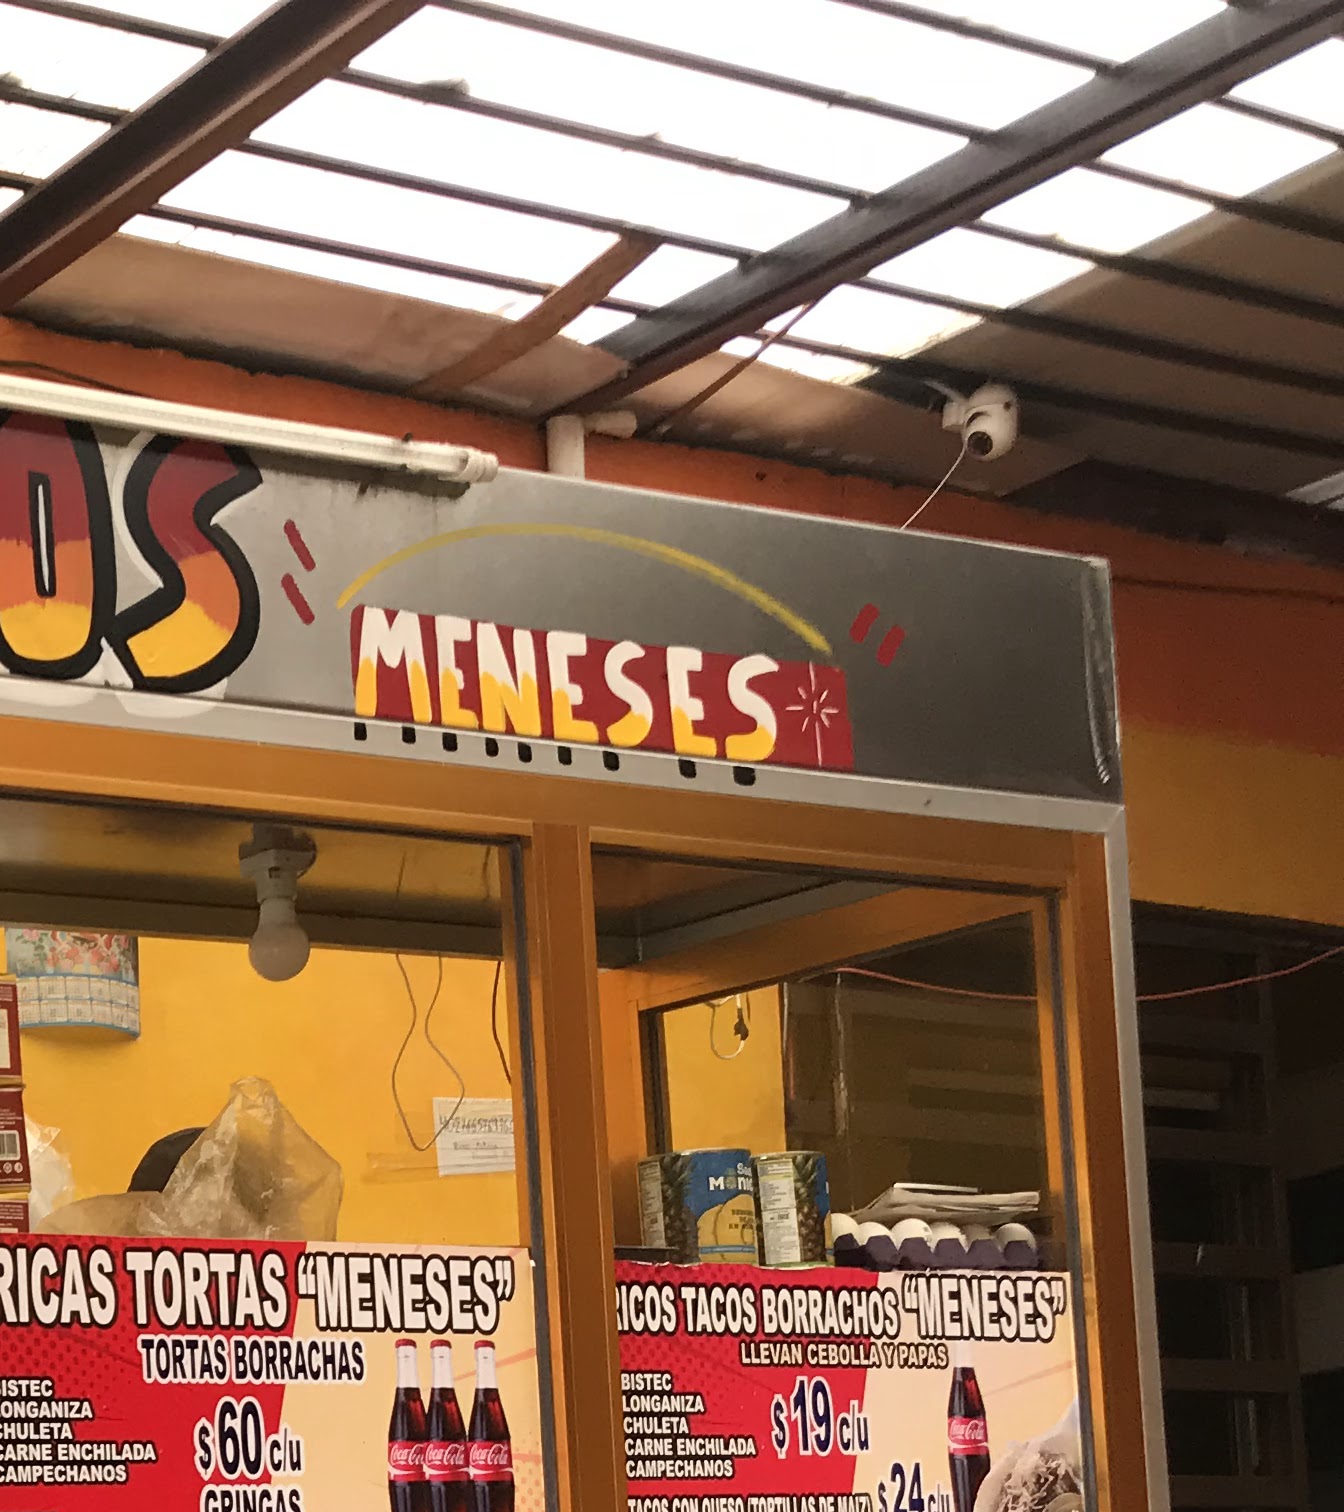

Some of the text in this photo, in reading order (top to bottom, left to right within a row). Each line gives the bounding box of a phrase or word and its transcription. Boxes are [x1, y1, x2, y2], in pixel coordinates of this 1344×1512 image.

[126, 1250, 288, 1329] TORTAS
[681, 1287, 756, 1333] TACOS
[762, 1289, 899, 1337] BORRACHOS
[140, 1338, 365, 1381] TORTAS BORRACHAS
[741, 1343, 947, 1366] LLEVAN CEBOLLA Y PAPAS
[621, 1373, 671, 1390] BISTEC
[622, 1395, 704, 1412] LONGANIZA
[623, 1417, 689, 1433] CHULETA
[839, 1404, 869, 1451] c/u
[57, 1443, 156, 1461] ENCHILADA
[269, 1426, 301, 1472] c/u
[624, 1438, 756, 1455] CARNE ENCHILADA
[626, 1460, 732, 1477] CAMPECHANOS
